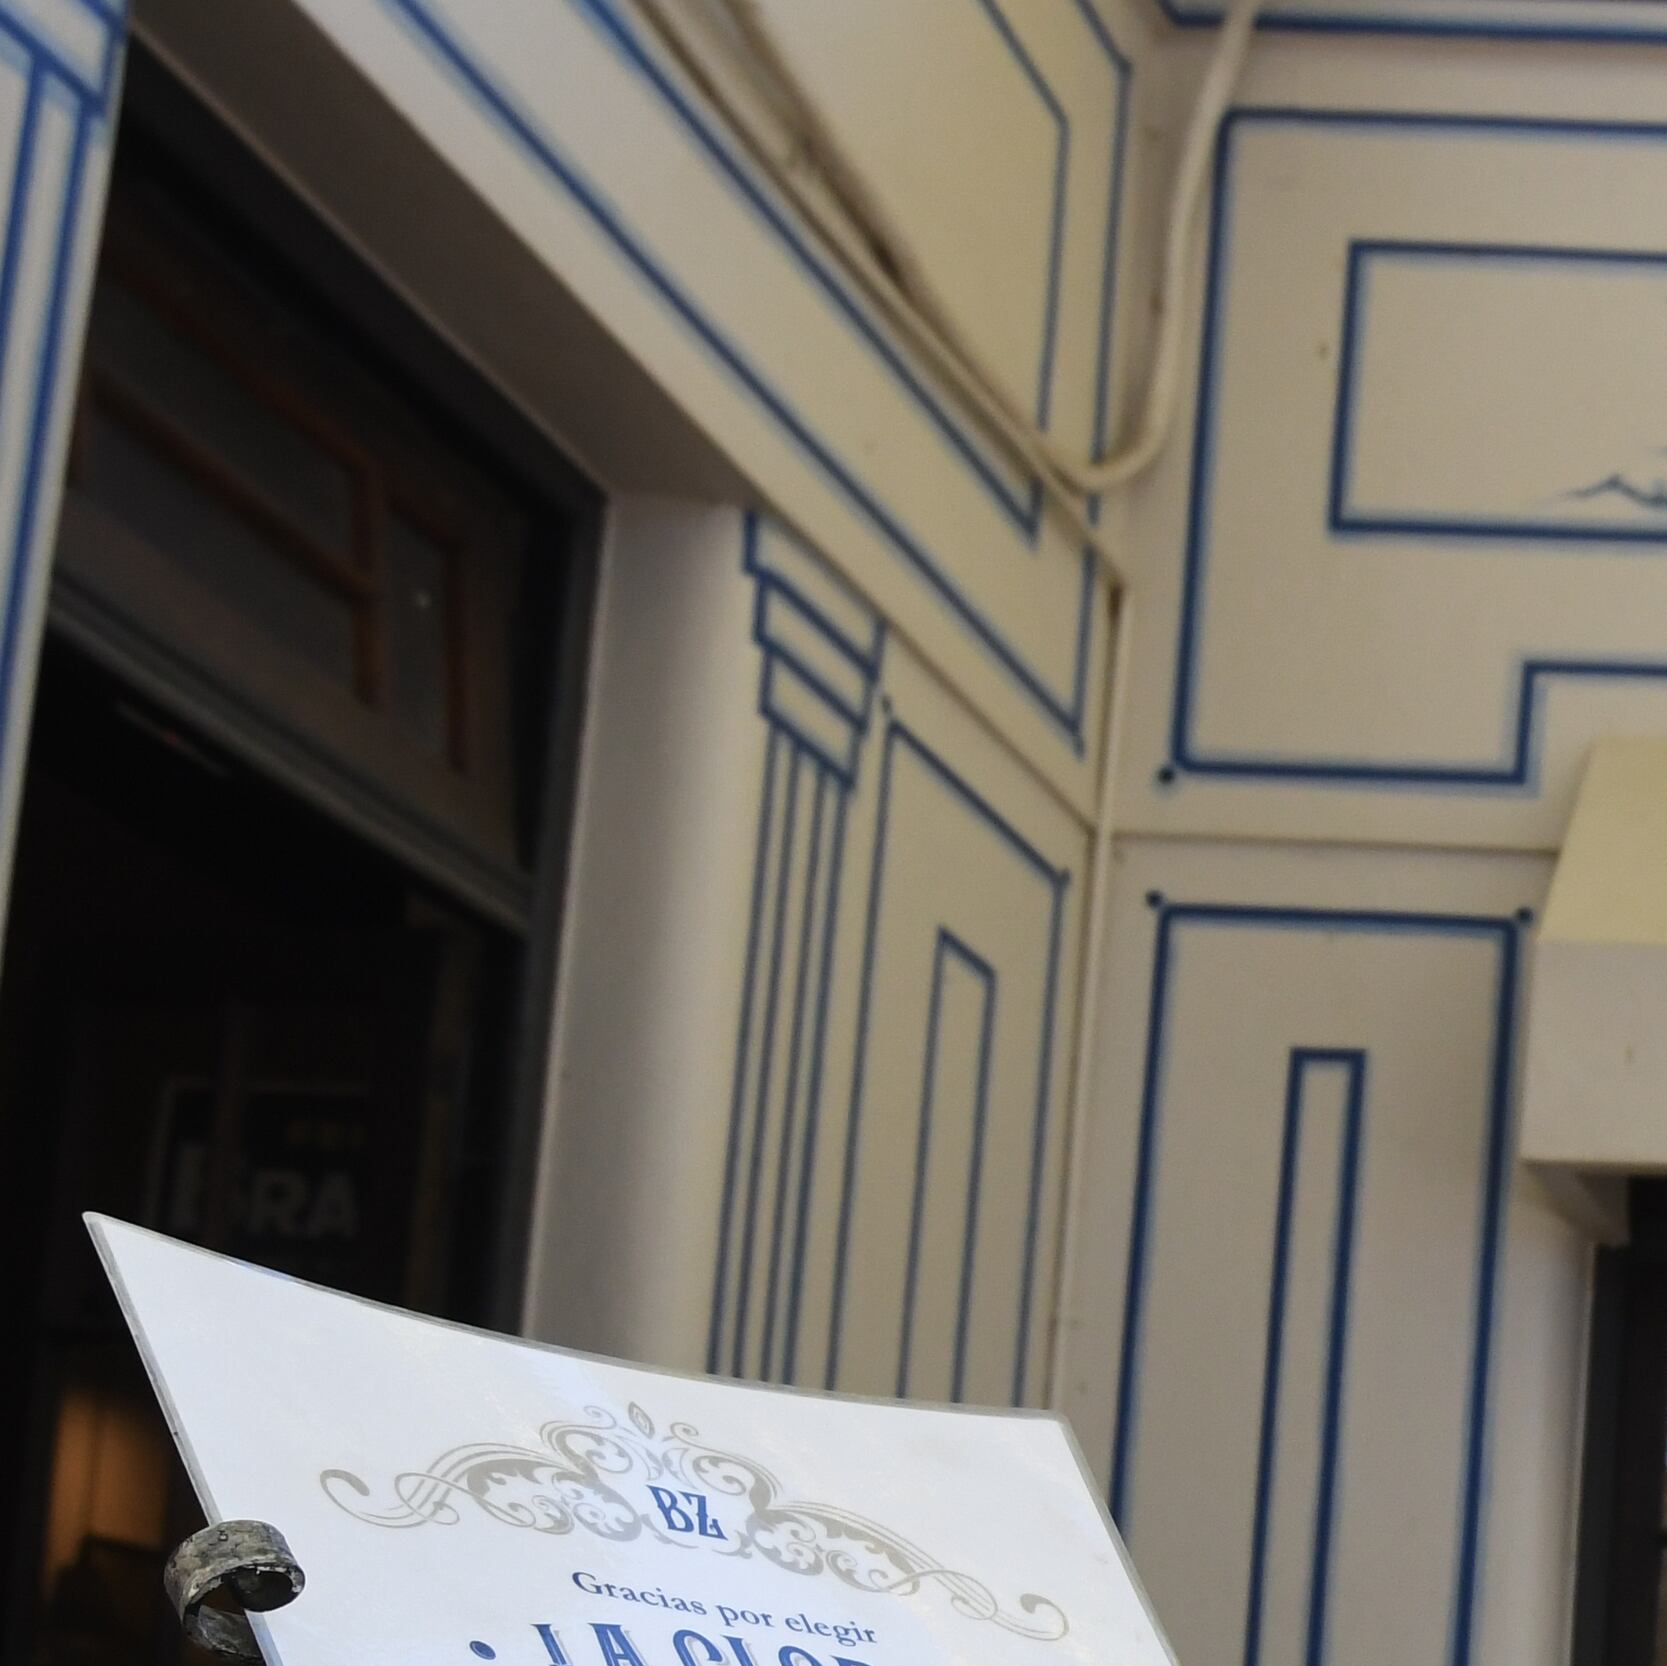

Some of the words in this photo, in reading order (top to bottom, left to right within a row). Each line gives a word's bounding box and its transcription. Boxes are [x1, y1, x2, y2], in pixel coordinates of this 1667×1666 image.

[646, 1485, 729, 1541] BZ
[571, 1571, 708, 1616] Gracias
[714, 1604, 775, 1628] por
[784, 1613, 877, 1647] elegir
